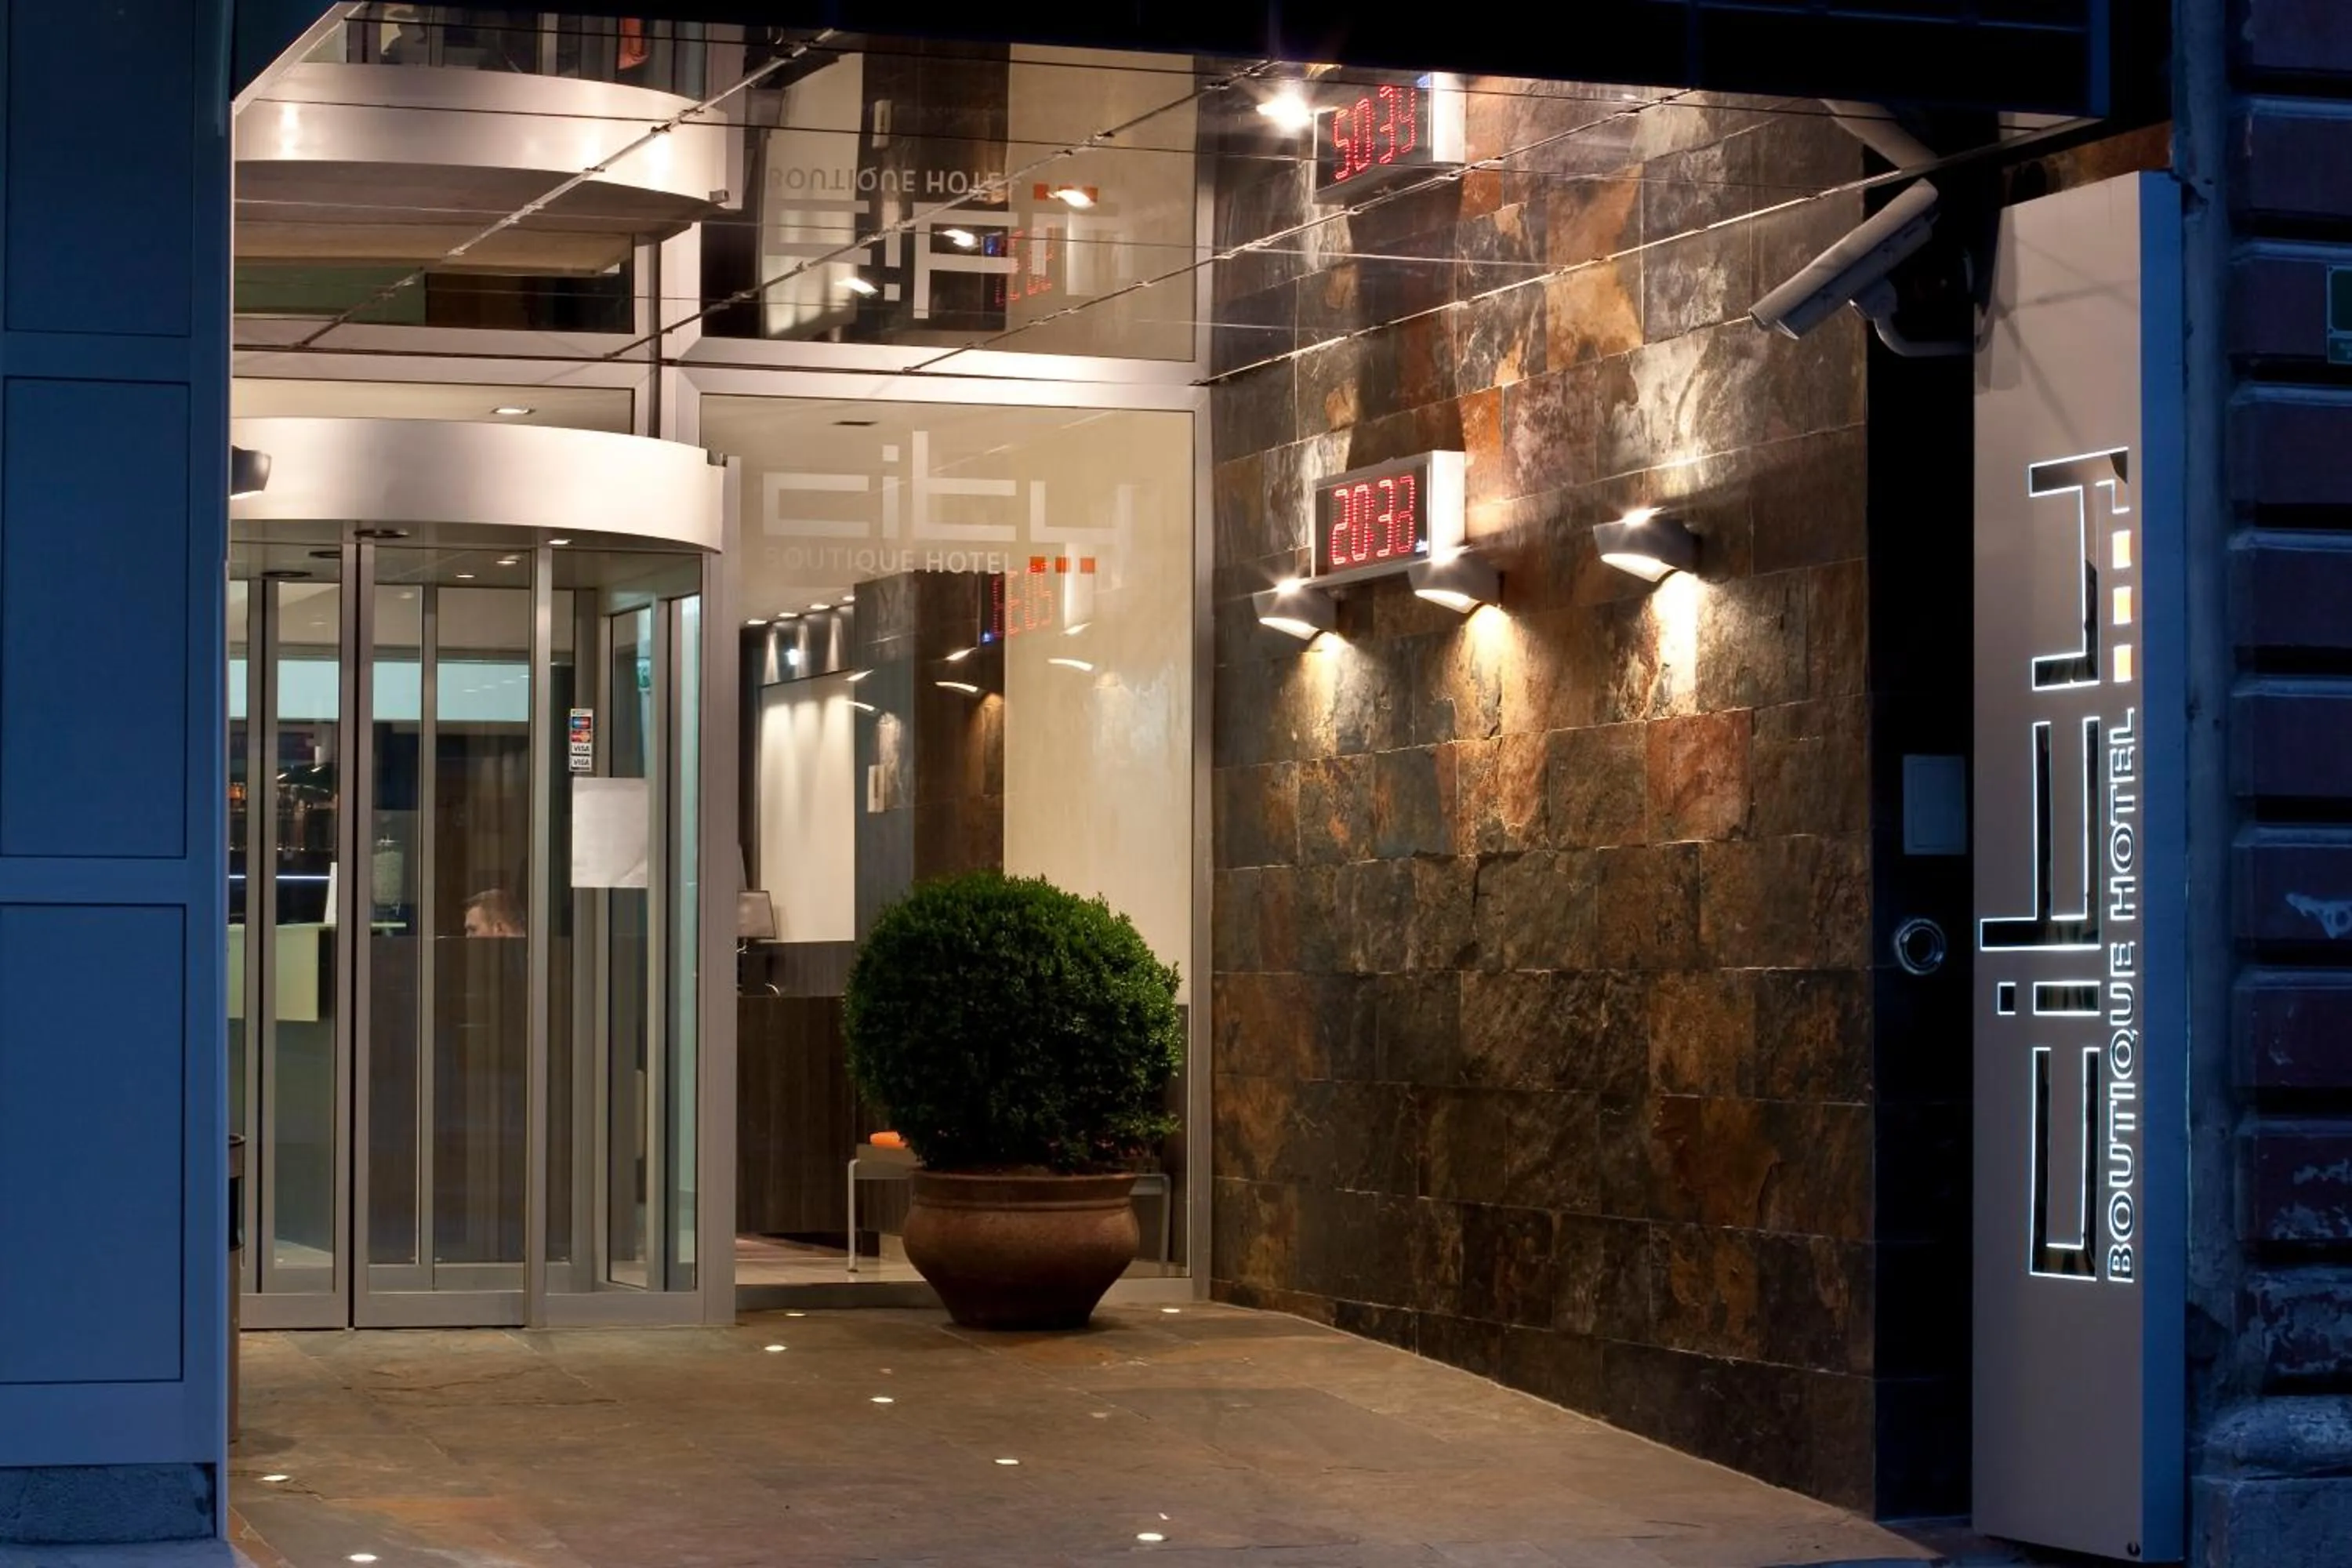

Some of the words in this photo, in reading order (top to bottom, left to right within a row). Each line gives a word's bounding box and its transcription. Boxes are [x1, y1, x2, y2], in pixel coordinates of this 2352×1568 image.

[765, 546, 914, 573] BOUTIQUE
[926, 550, 1014, 575] HOTEL
[2109, 707, 2136, 920] HOTEL
[2107, 941, 2138, 1283] BOUTIQUE
